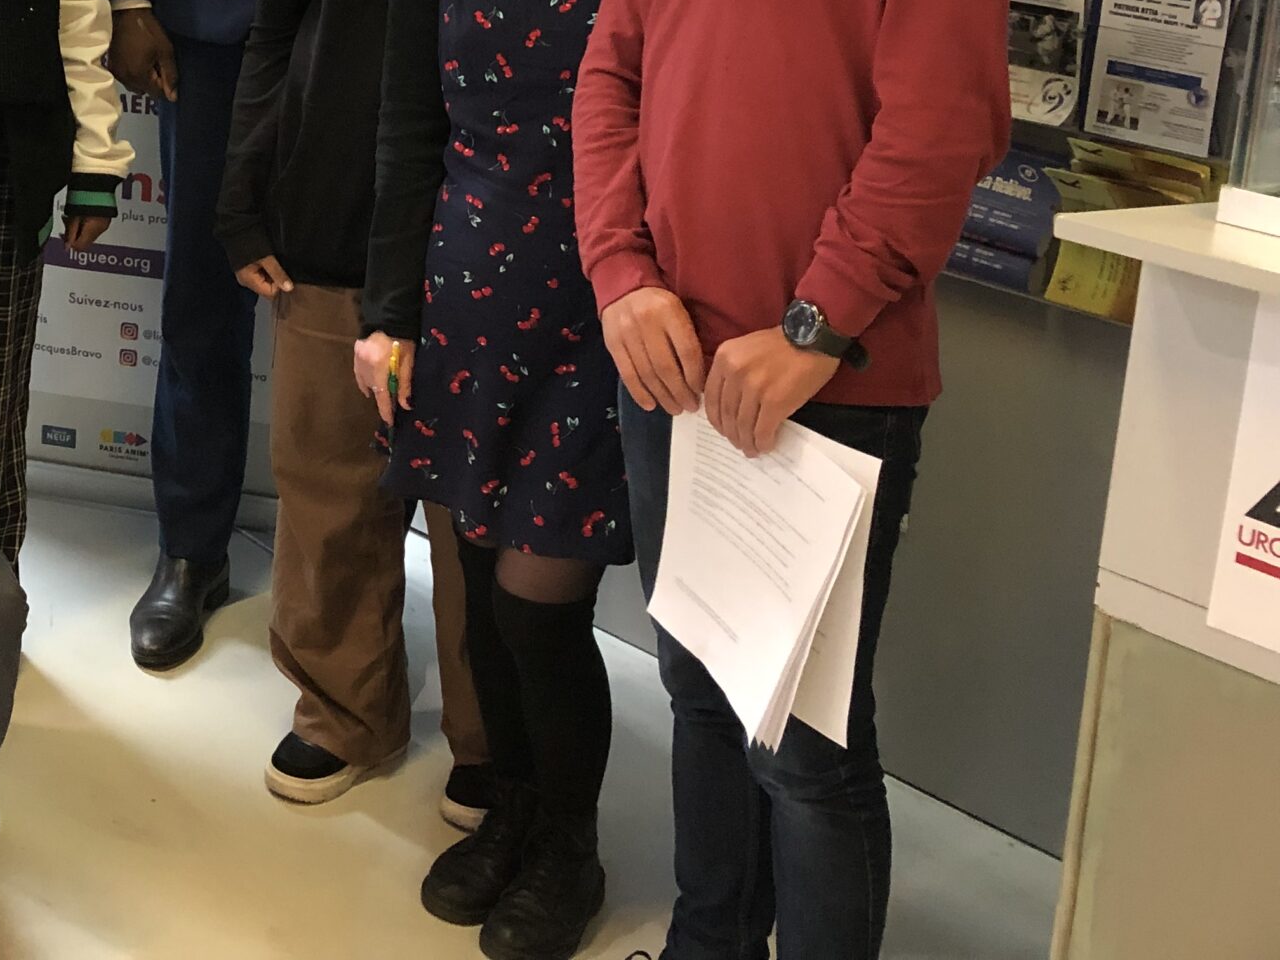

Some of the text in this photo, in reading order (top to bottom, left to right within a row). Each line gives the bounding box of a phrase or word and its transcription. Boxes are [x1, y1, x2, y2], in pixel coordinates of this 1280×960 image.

[121, 210, 169, 225] plus pro
[68, 292, 144, 313] Suivez-nous
[141, 355, 158, 367] @c
[46, 431, 71, 443] NEUF
[99, 444, 122, 454] PARIS
